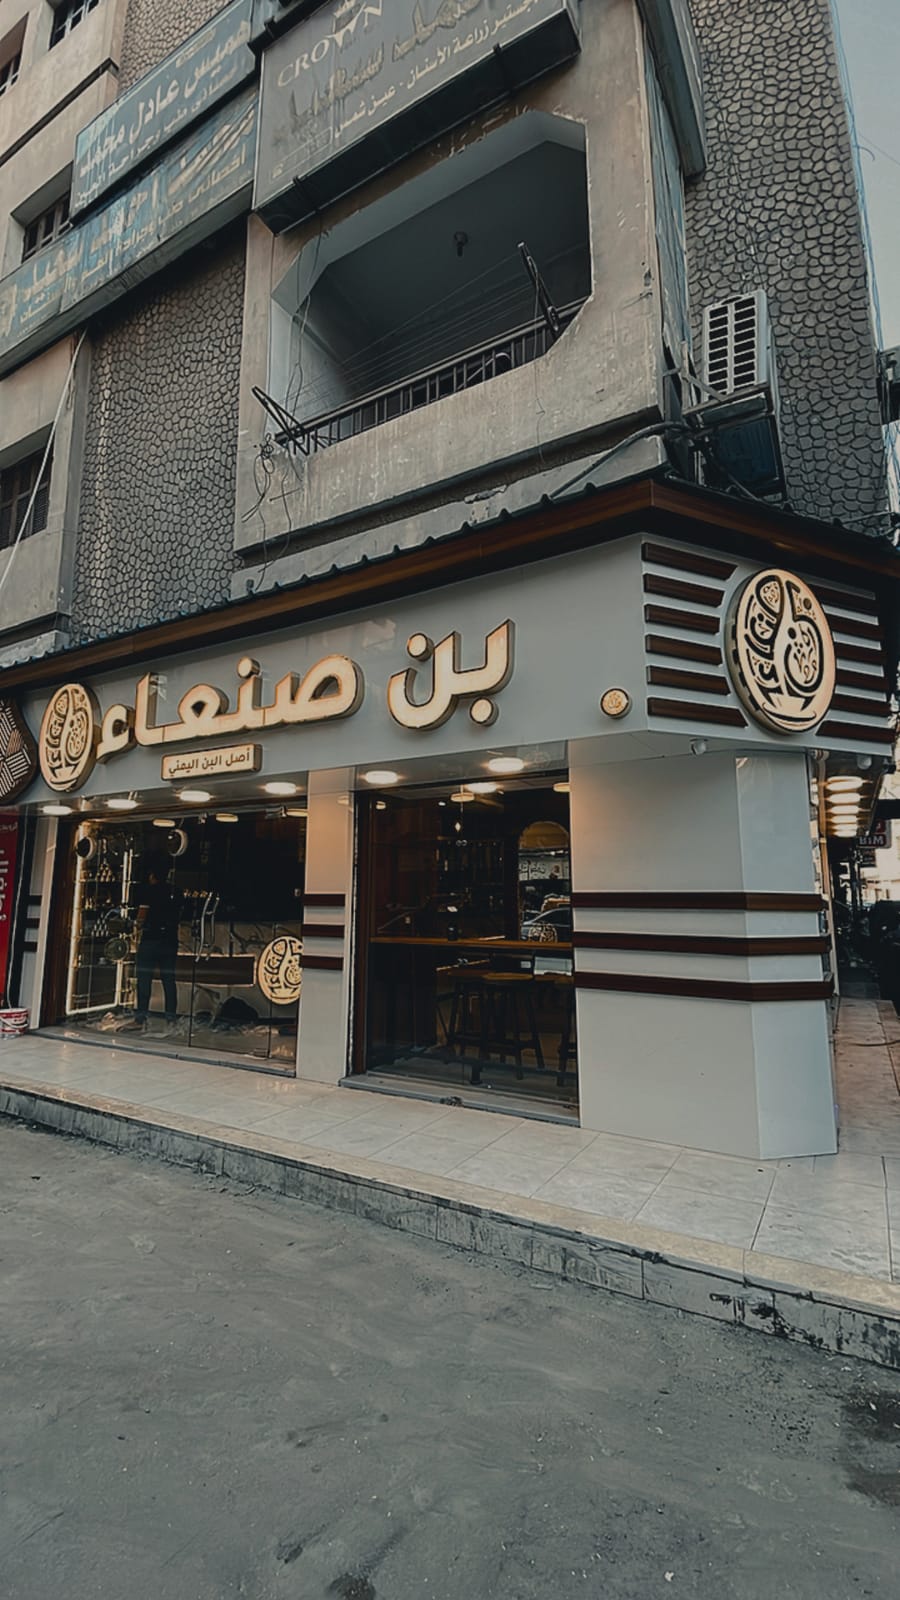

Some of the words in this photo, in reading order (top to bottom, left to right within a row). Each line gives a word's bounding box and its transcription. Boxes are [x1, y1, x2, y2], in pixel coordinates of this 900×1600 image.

[387, 618, 515, 731] بن
[96, 656, 364, 763] صنعاء
[201, 755, 222, 770] البن
[225, 747, 250, 767] أصل
[168, 759, 199, 777] اليمني
